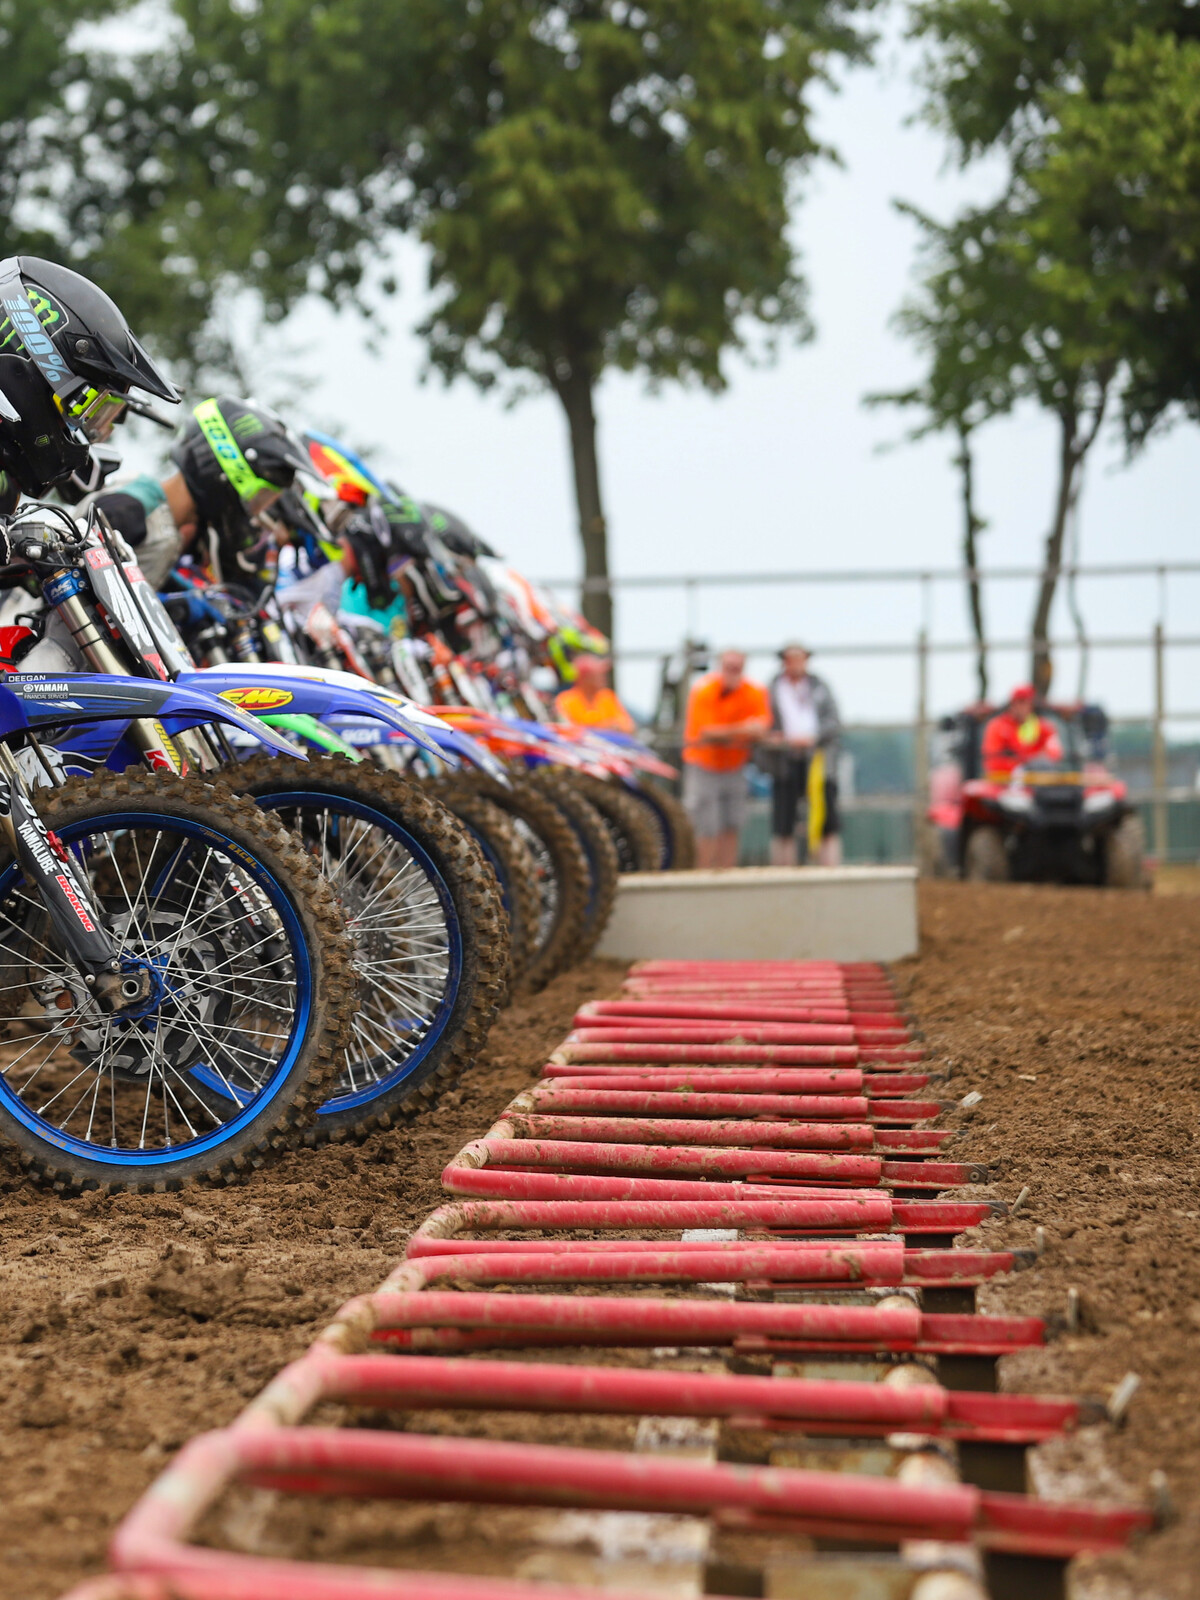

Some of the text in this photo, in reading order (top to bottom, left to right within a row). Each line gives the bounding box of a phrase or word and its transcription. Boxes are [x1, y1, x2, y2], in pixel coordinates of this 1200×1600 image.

[3, 294, 71, 382] 100%
[8, 675, 46, 683] DEEGAN
[33, 683, 69, 692] YAMAHA
[217, 689, 293, 705] FMF
[17, 819, 58, 876] YAMALUBE
[227, 843, 257, 870] EXCEL
[55, 874, 96, 933] BRAKING
